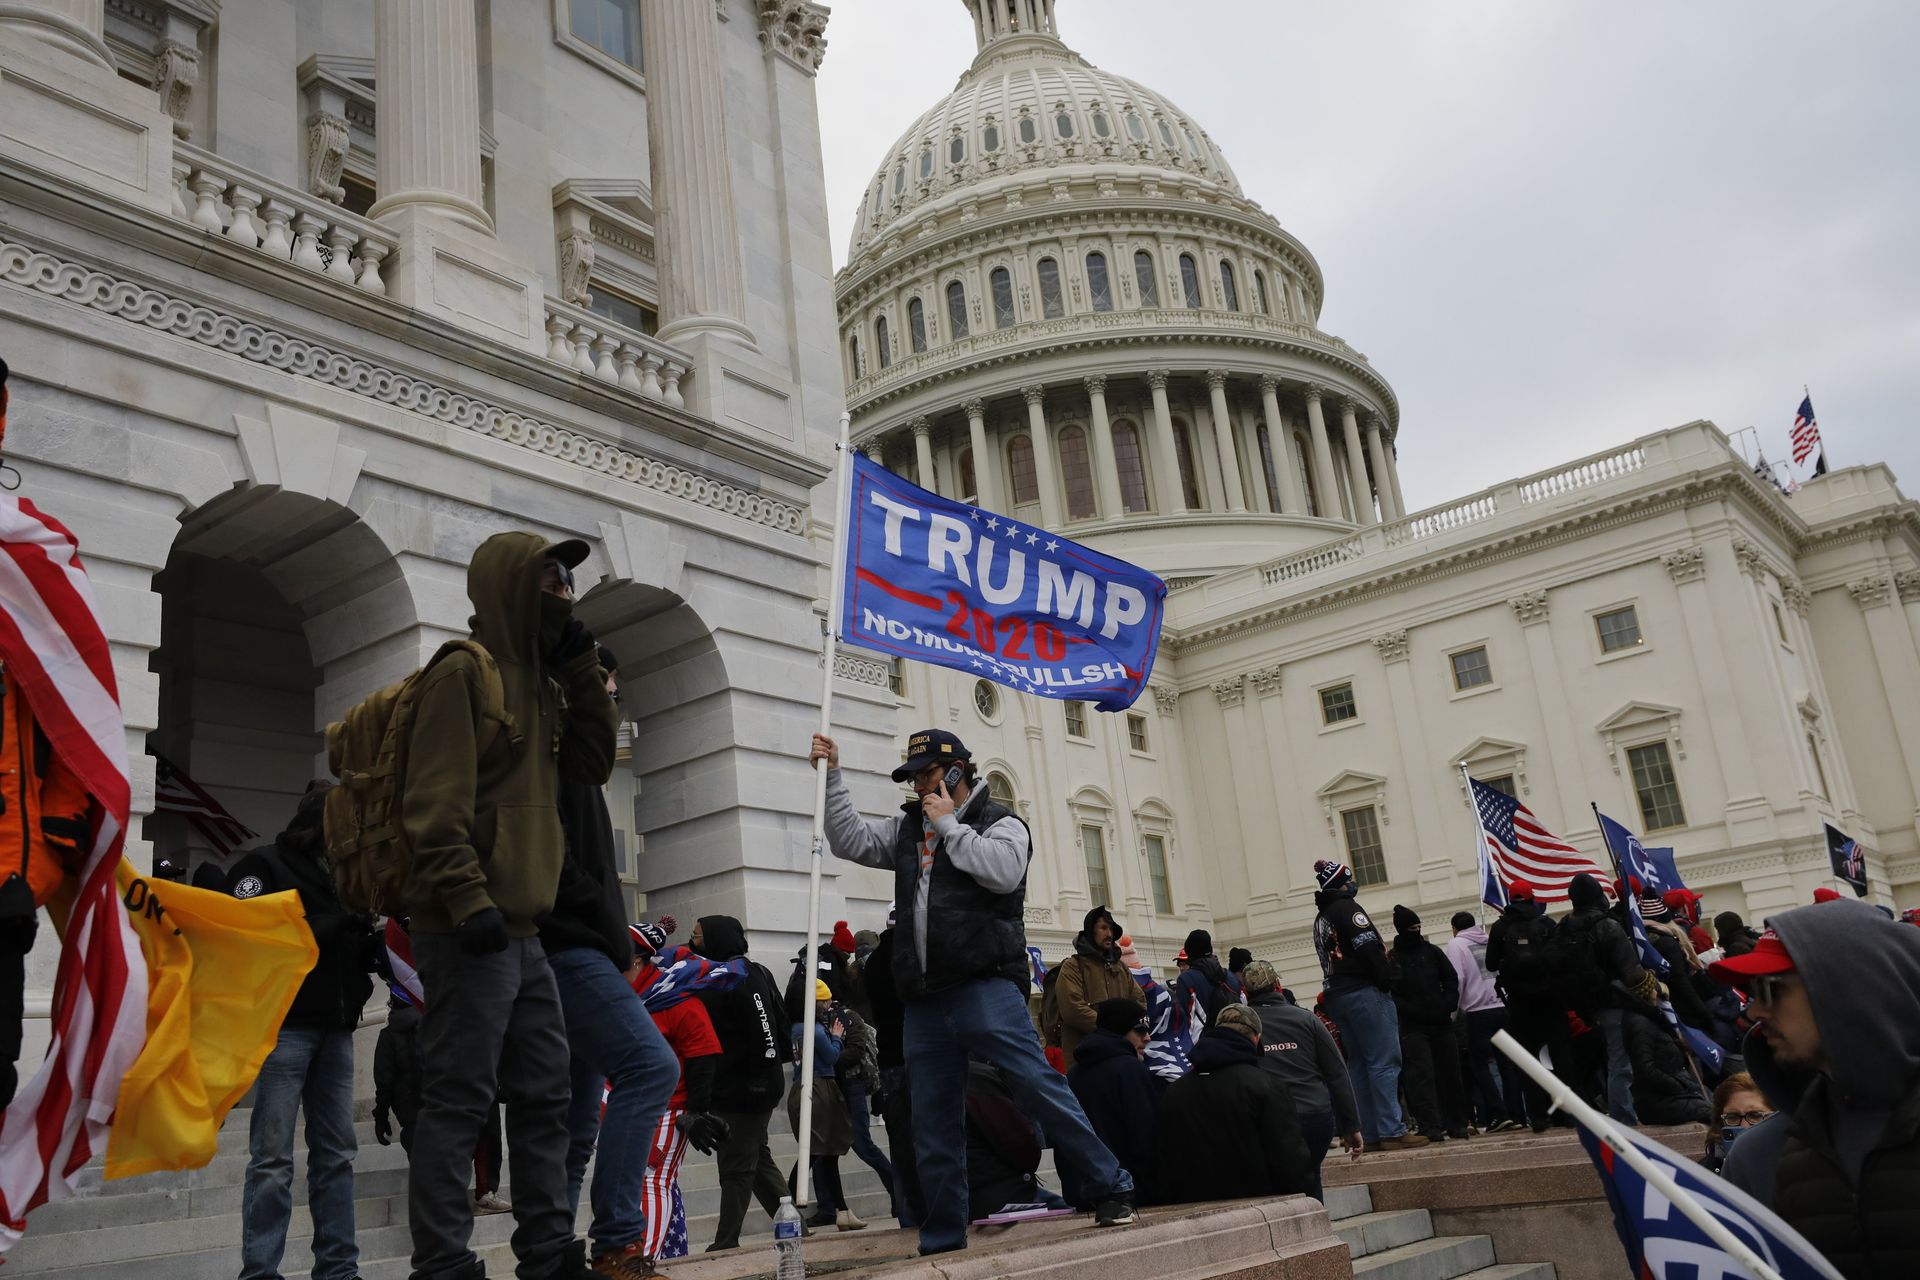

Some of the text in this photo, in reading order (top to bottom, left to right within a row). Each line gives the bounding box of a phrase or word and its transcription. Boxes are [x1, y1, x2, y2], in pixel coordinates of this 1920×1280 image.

[871, 490, 1147, 640] TRUMP
[863, 607, 911, 640] NO
[946, 591, 1067, 662] 2020
[753, 992, 775, 1048] carhartt
